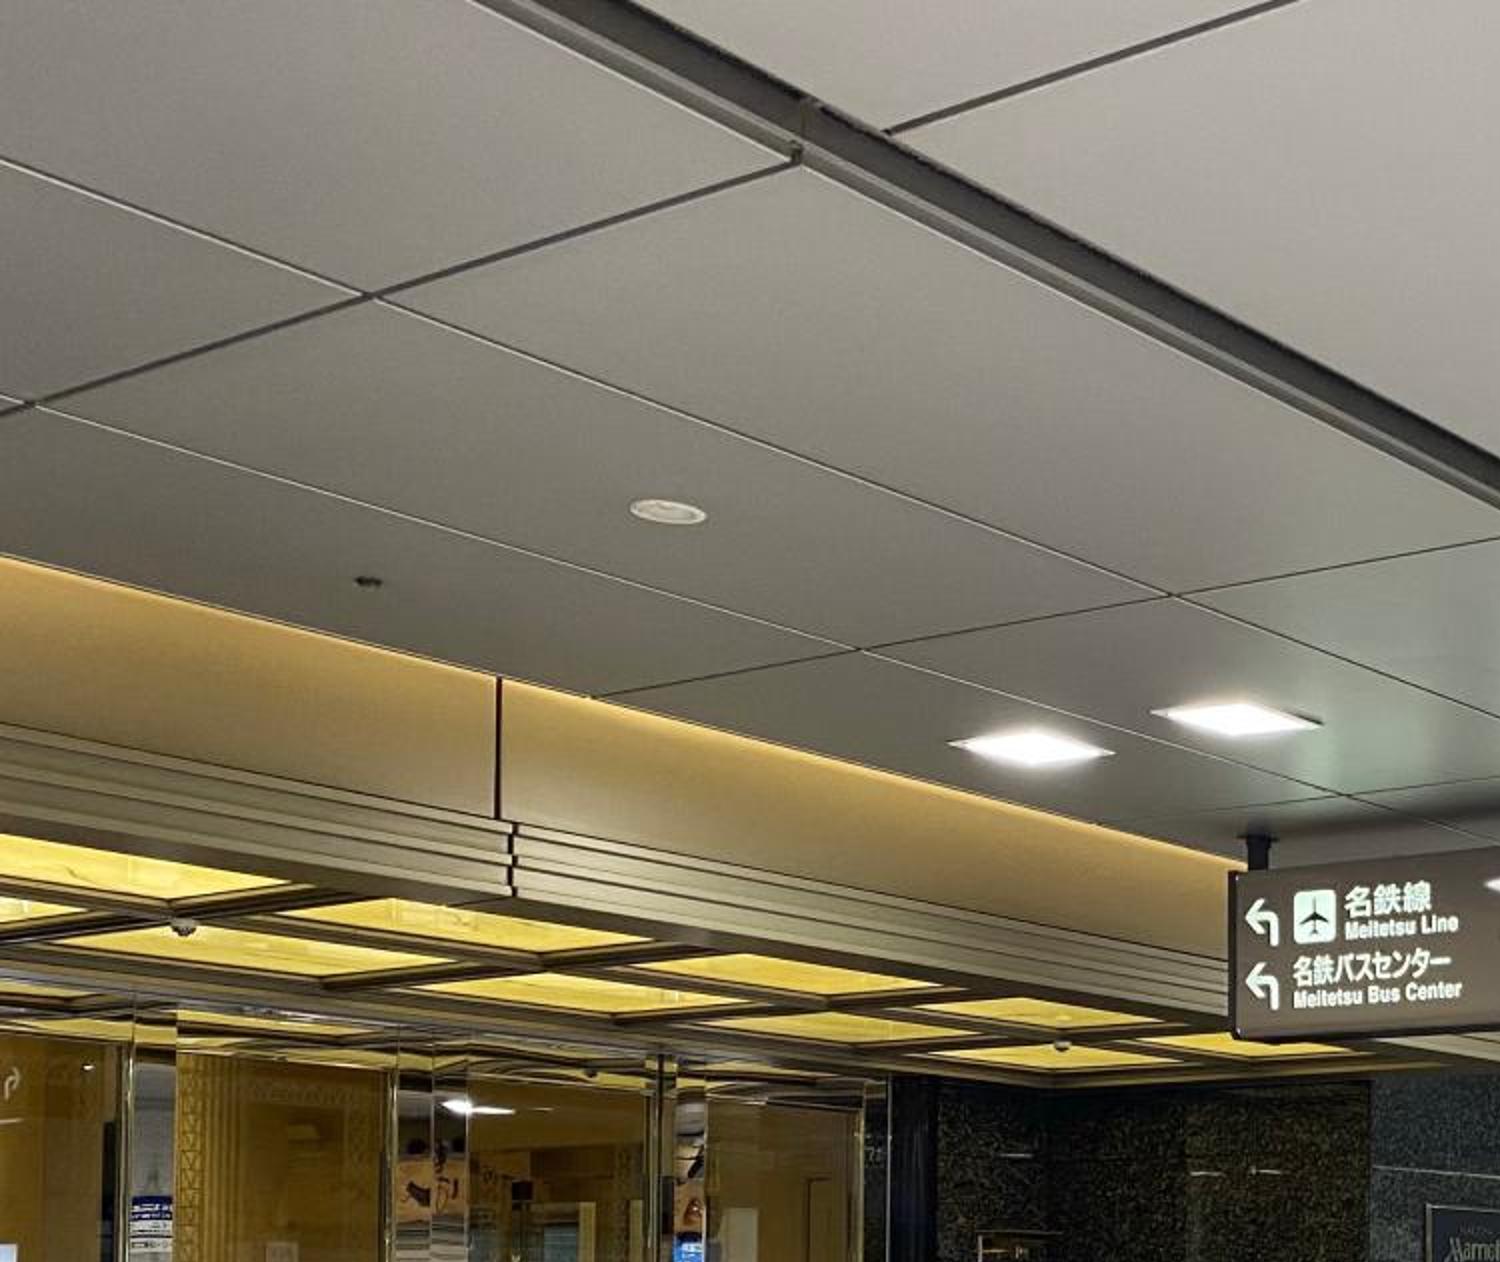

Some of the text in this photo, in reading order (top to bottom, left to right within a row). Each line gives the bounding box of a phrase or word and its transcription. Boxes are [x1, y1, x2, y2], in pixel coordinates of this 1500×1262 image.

[1344, 880, 1432, 918] 名鉄線
[1345, 914, 1459, 941] Meitetsu Line
[1293, 947, 1452, 987] 名鉄バスセンター
[1293, 981, 1463, 1009] Meitetsu Bus Center
